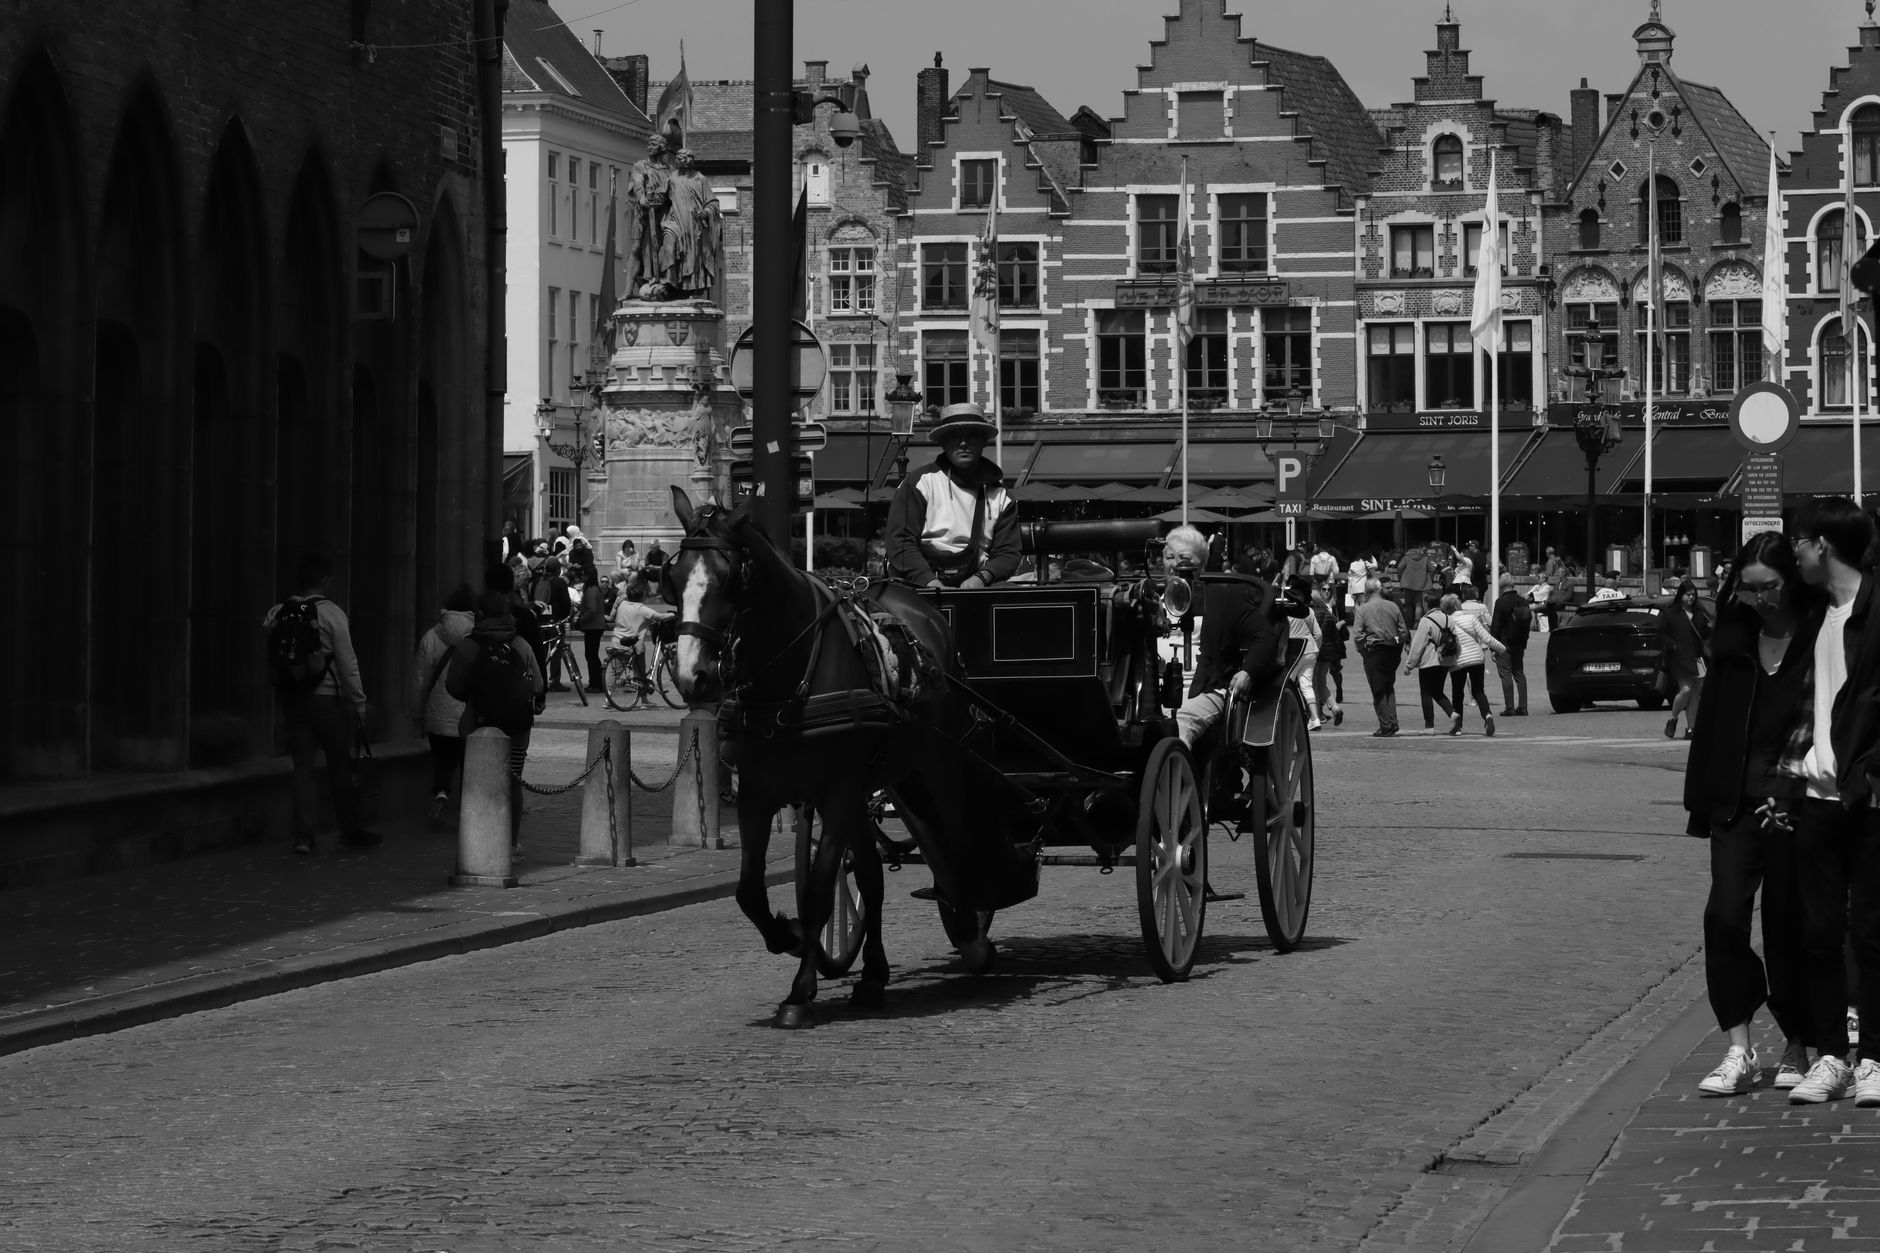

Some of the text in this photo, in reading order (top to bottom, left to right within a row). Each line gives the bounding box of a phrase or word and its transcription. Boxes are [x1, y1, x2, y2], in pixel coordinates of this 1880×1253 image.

[1154, 286, 1229, 305] PAIER
[1419, 415, 1479, 426] SINT JORIS
[1279, 457, 1302, 493] P
[1278, 503, 1302, 514] TAXI
[1312, 503, 1354, 511] Restaurant
